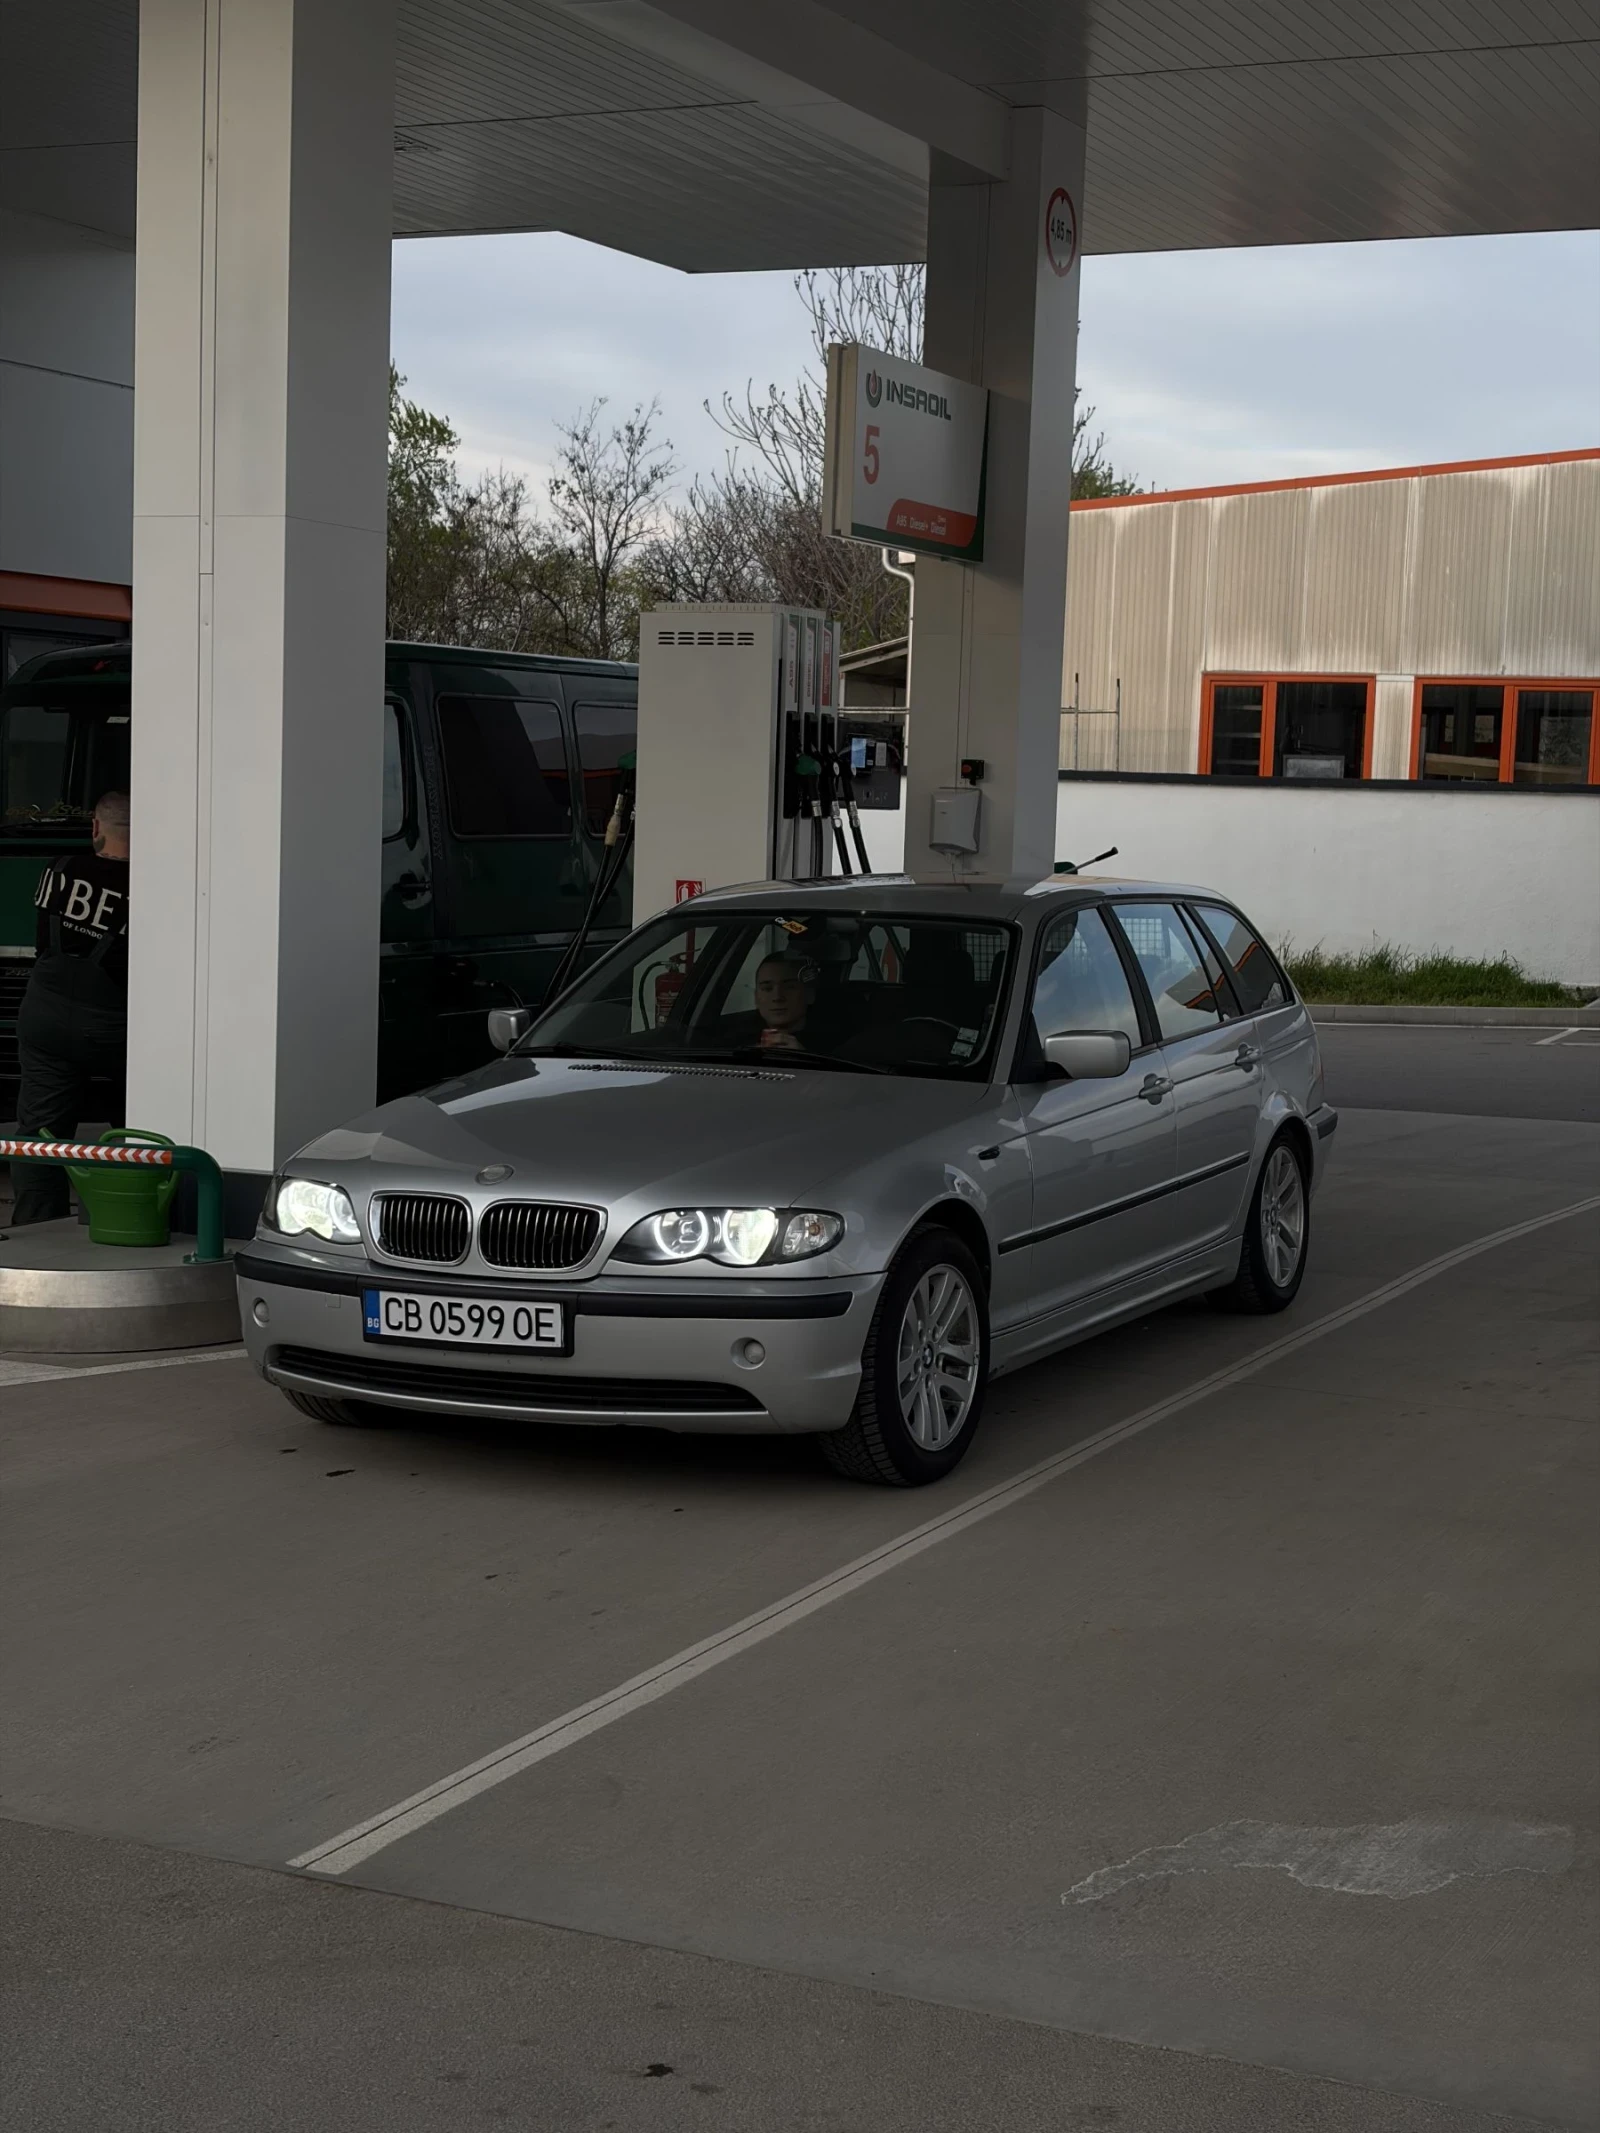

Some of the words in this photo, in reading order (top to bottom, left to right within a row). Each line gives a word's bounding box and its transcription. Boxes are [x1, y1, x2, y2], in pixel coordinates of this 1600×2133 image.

[886, 379, 951, 421] INSAOIL
[863, 425, 880, 485] 5
[62, 921, 75, 930] OF
[366, 1317, 379, 1329] BG
[384, 1297, 422, 1332] CB
[429, 1301, 504, 1339] 0599
[513, 1307, 555, 1342] OE
